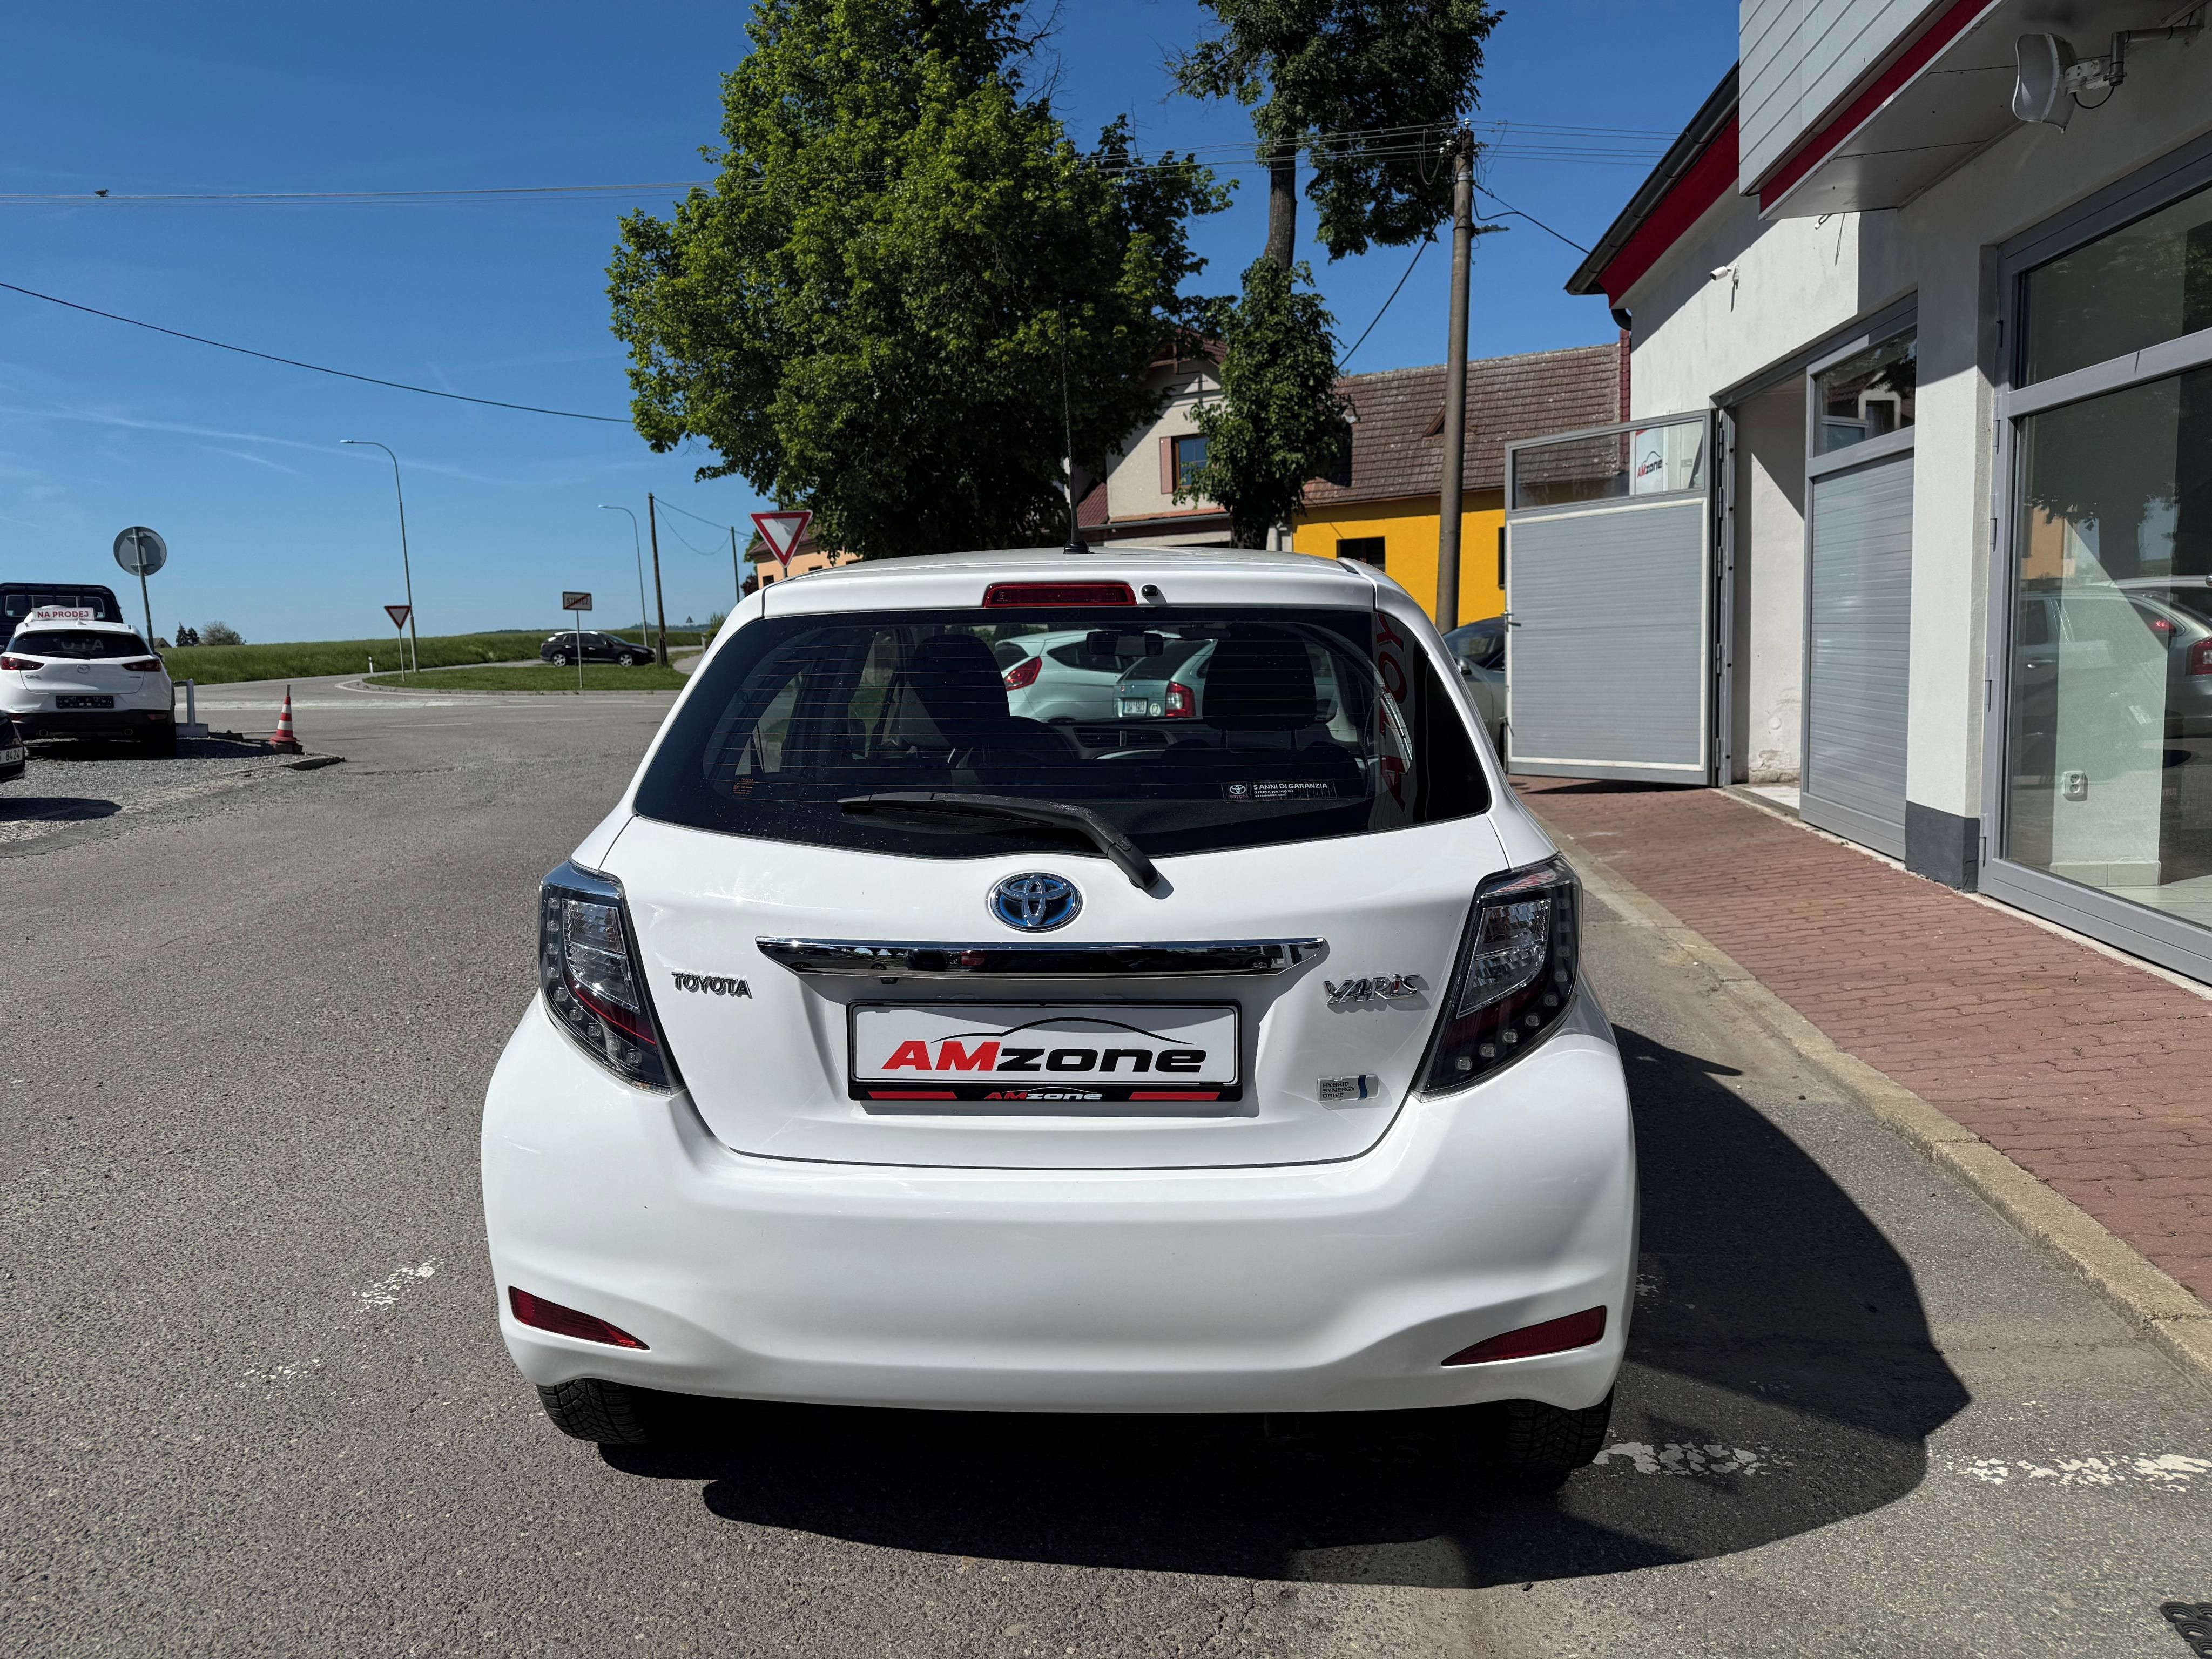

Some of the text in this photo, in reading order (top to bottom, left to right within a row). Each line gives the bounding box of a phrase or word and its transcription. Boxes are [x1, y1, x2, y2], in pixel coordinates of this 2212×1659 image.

[5, 749, 20, 761] 8424
[671, 972, 752, 999] TOYOTA
[881, 1040, 1208, 1073] AMzone
[984, 1092, 1103, 1100] AMzone
